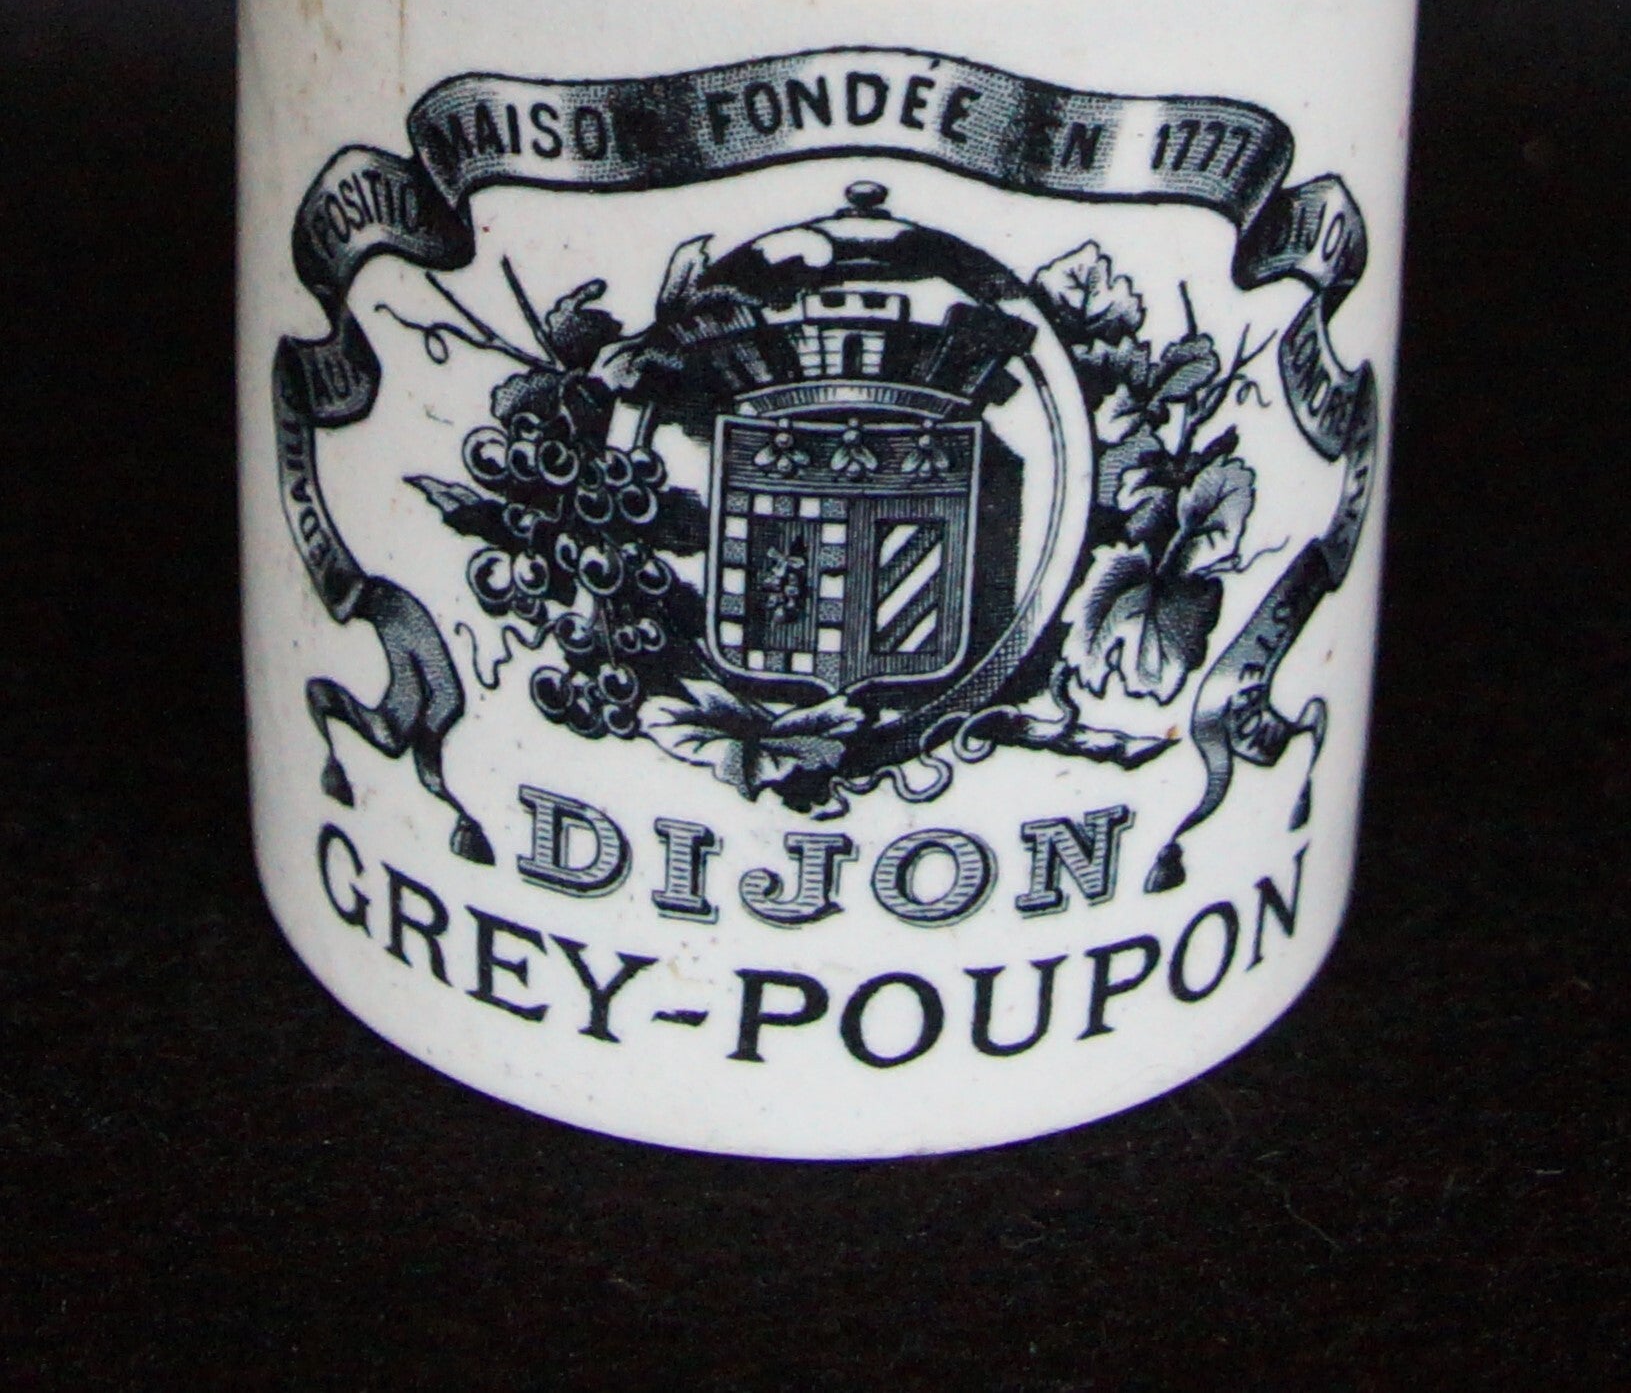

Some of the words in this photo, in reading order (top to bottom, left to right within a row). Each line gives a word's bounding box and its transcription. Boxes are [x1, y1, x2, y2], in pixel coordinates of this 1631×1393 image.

[1150, 118, 1252, 179] 1777
[516, 783, 1137, 930] DIJON
[316, 822, 1311, 1069] GREY-POUPON
